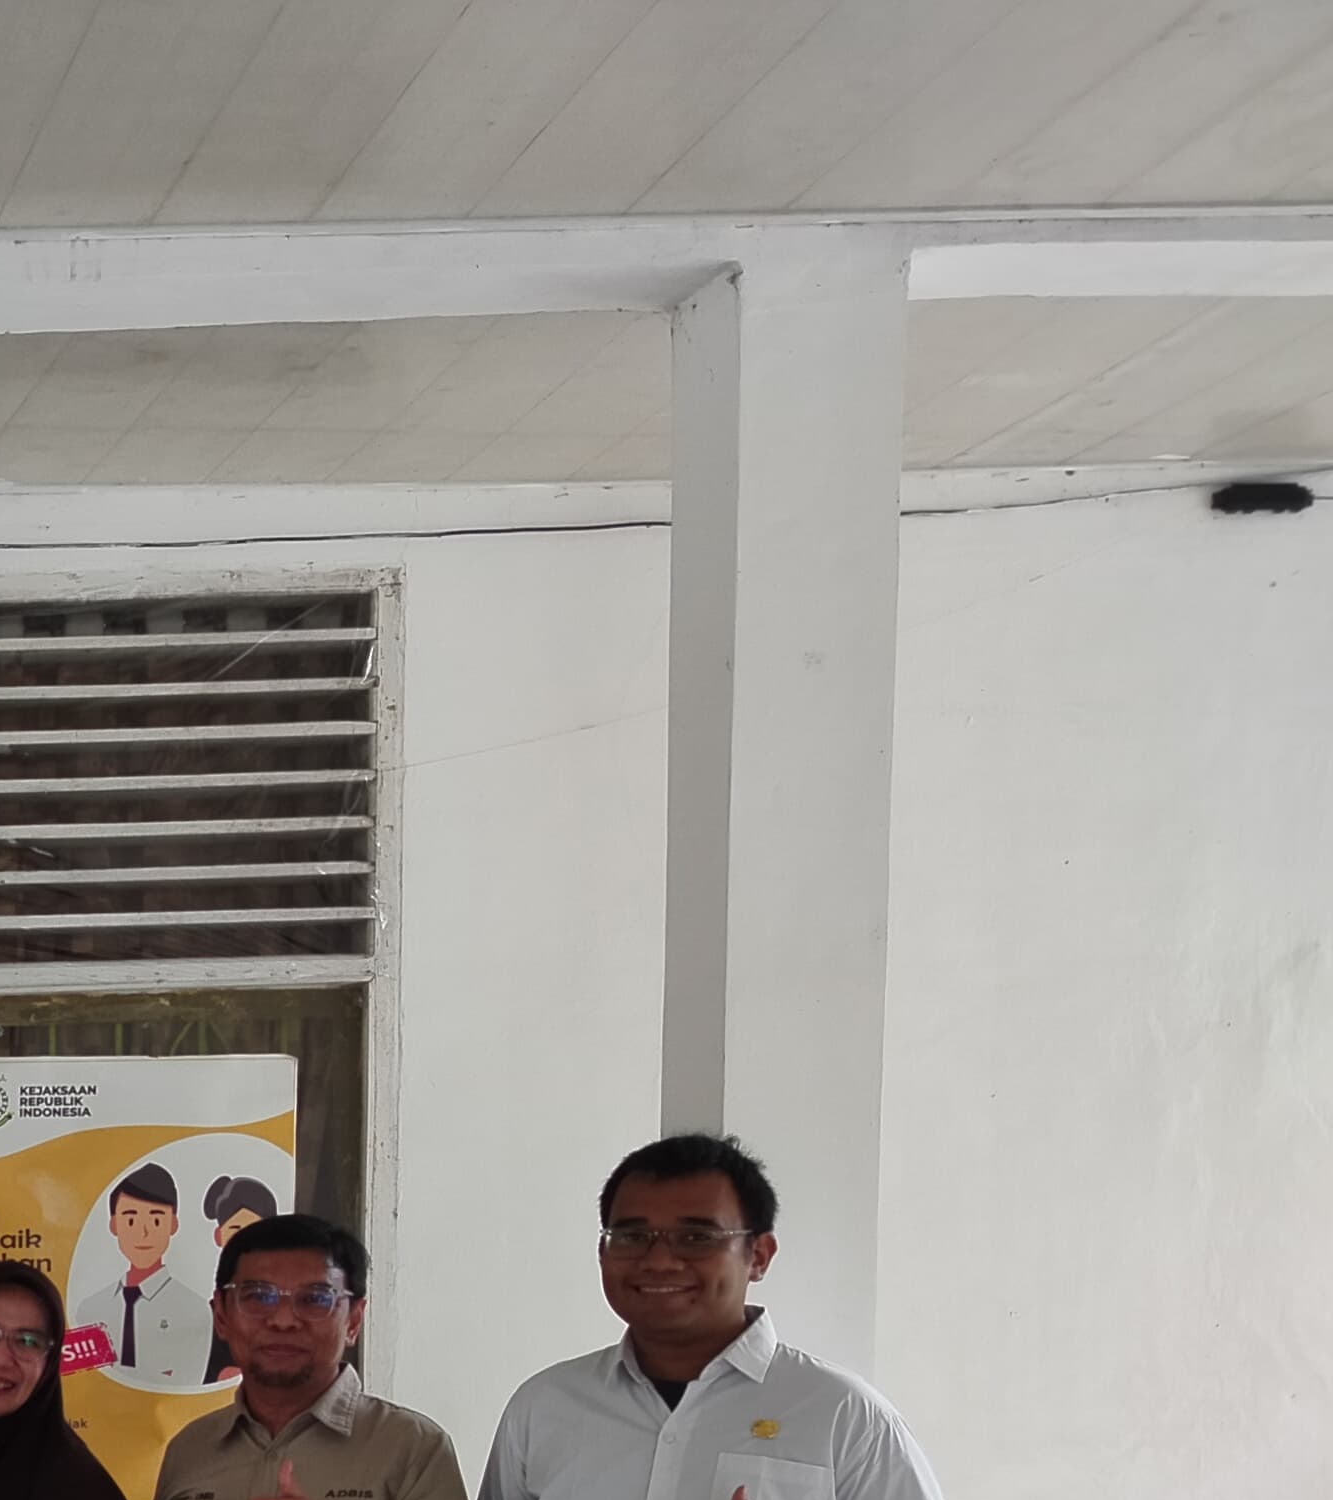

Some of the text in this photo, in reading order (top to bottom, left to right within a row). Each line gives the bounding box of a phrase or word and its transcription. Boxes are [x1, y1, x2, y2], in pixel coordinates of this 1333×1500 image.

[19, 1085, 97, 1097] KEJAKSAAN
[19, 1096, 84, 1107] REPUBLIK
[19, 1106, 91, 1118] INDONESIA
